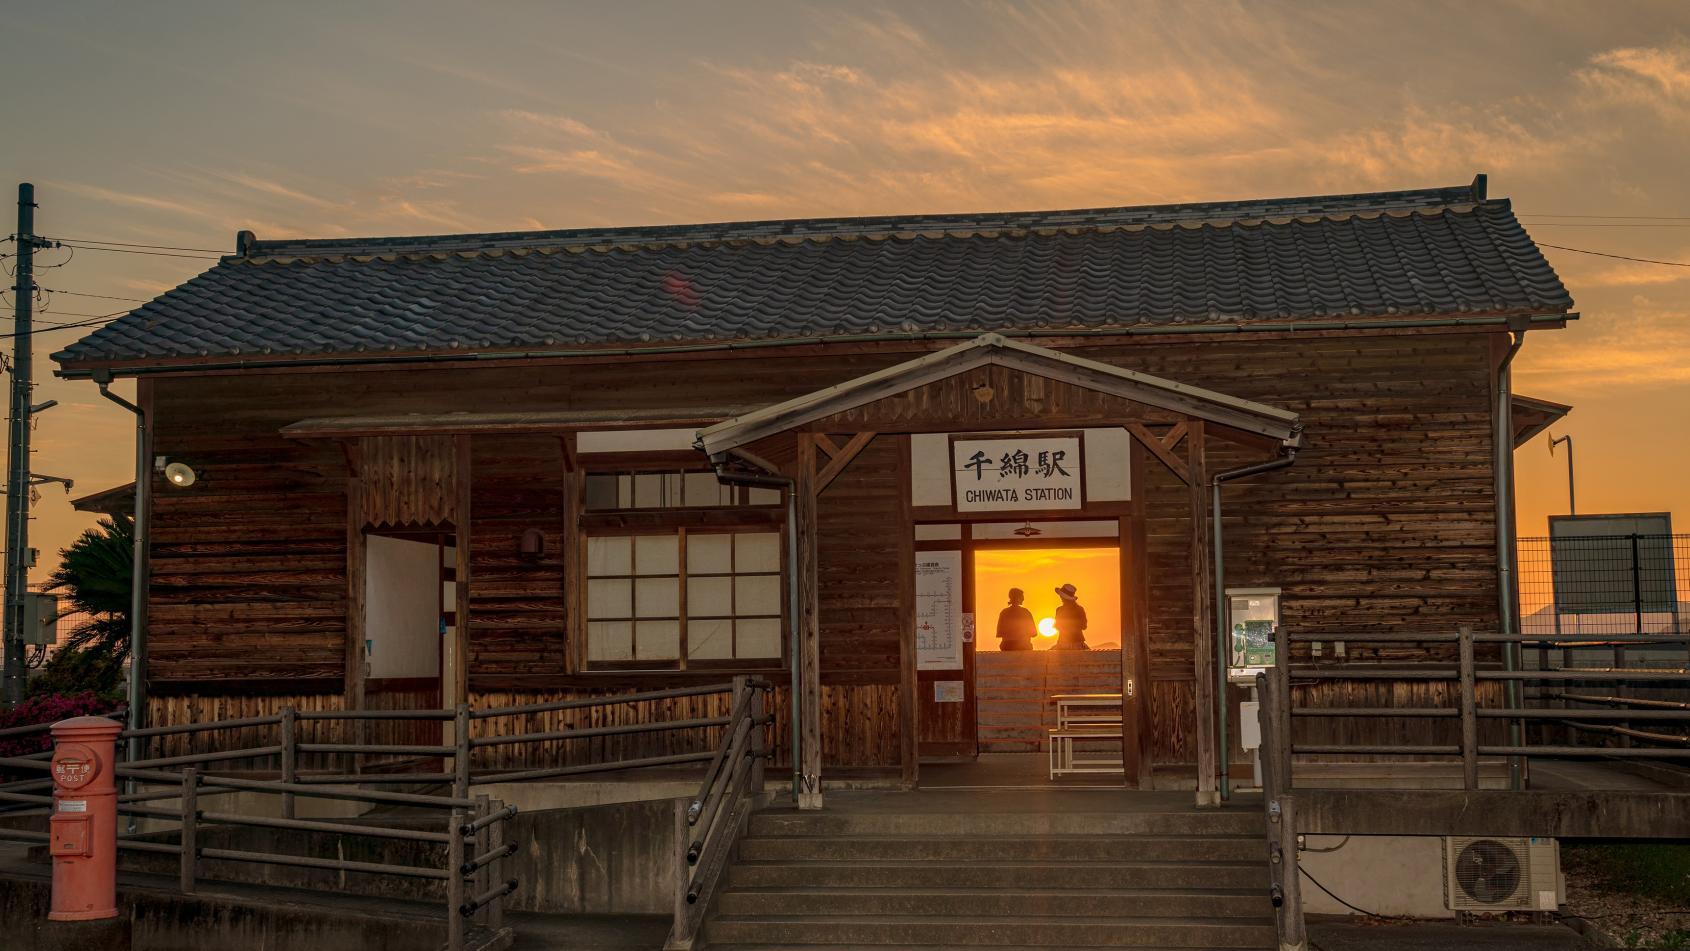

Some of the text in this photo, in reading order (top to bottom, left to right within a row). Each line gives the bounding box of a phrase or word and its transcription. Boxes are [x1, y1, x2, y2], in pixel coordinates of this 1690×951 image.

[964, 449, 1071, 481] 千綿駅
[31, 490, 36, 501] 3
[966, 488, 1072, 502] CHIWATA STATION
